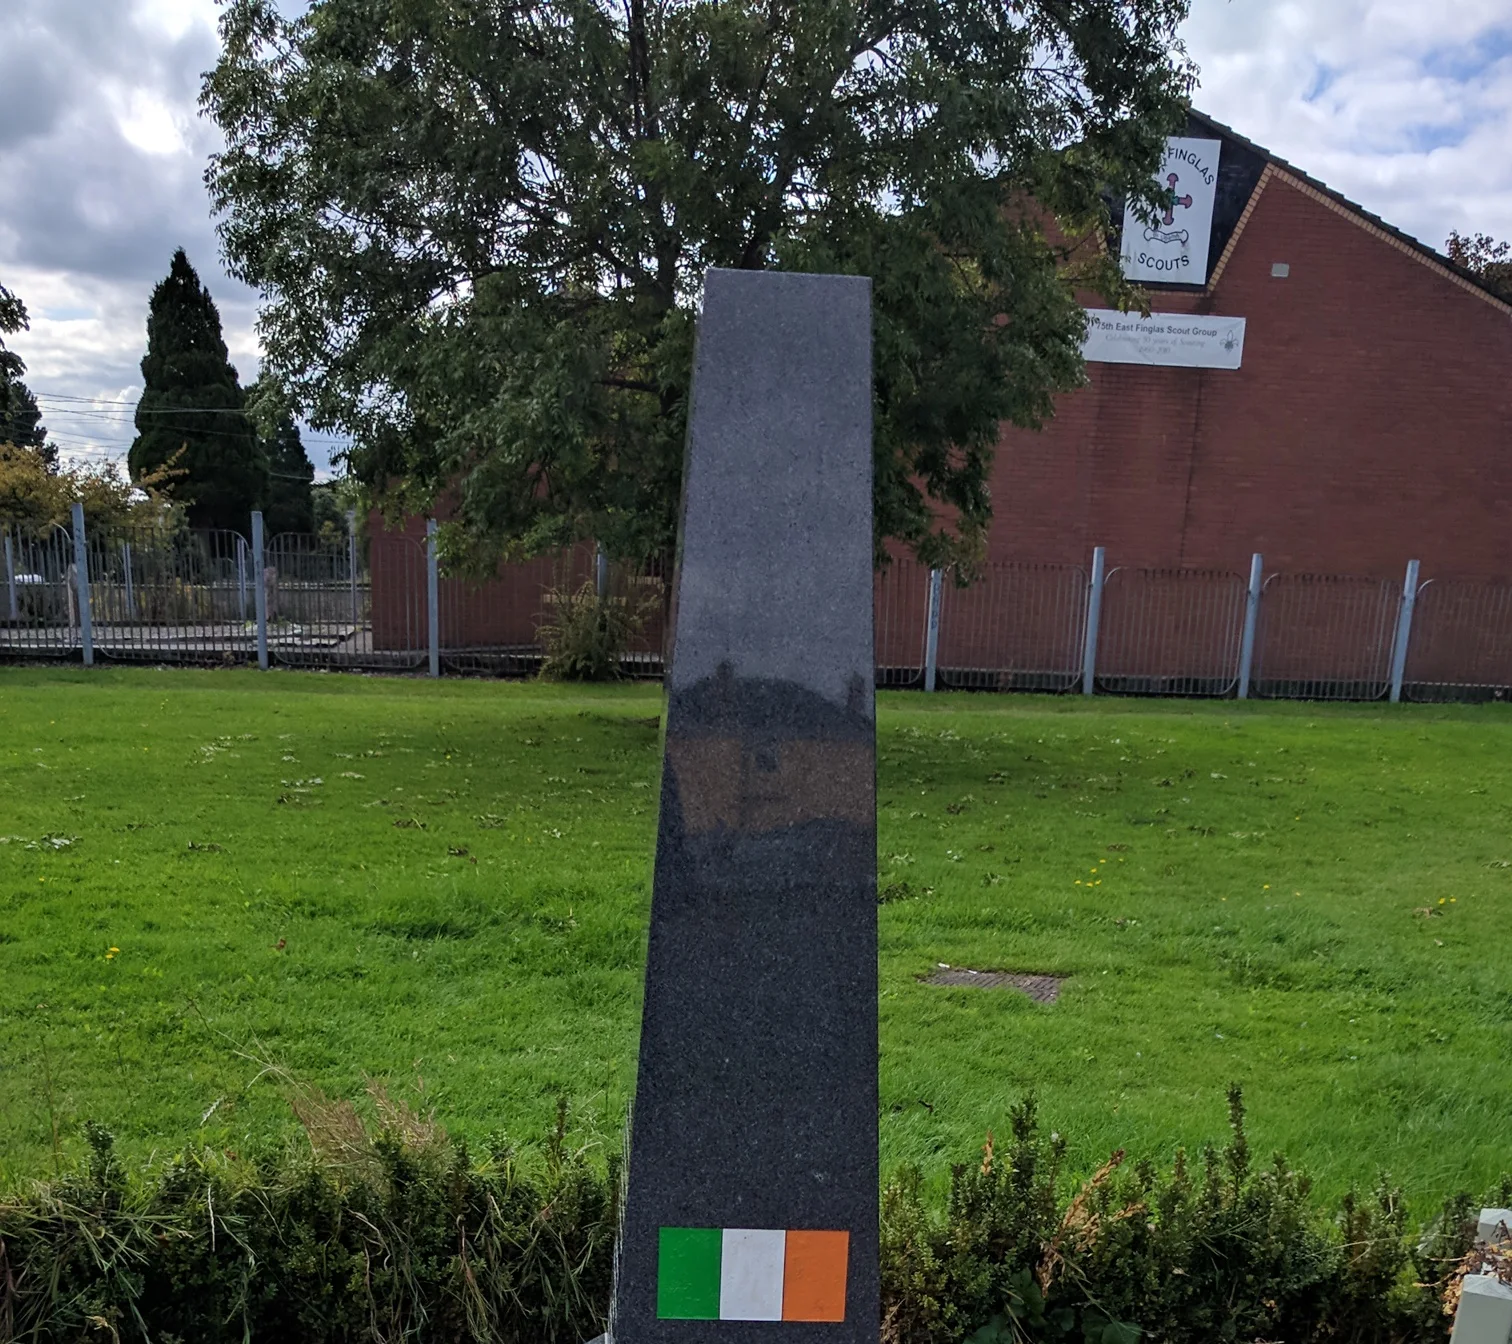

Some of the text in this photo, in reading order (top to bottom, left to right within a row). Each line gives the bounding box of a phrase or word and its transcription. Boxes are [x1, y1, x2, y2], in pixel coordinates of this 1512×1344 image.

[1167, 146, 1214, 185] FINGLAS
[1137, 252, 1190, 271] SCOUTS
[1115, 322, 1134, 332] East
[1135, 323, 1165, 335] Finglas
[1166, 325, 1190, 335] Scout
[1191, 326, 1218, 338] Group
